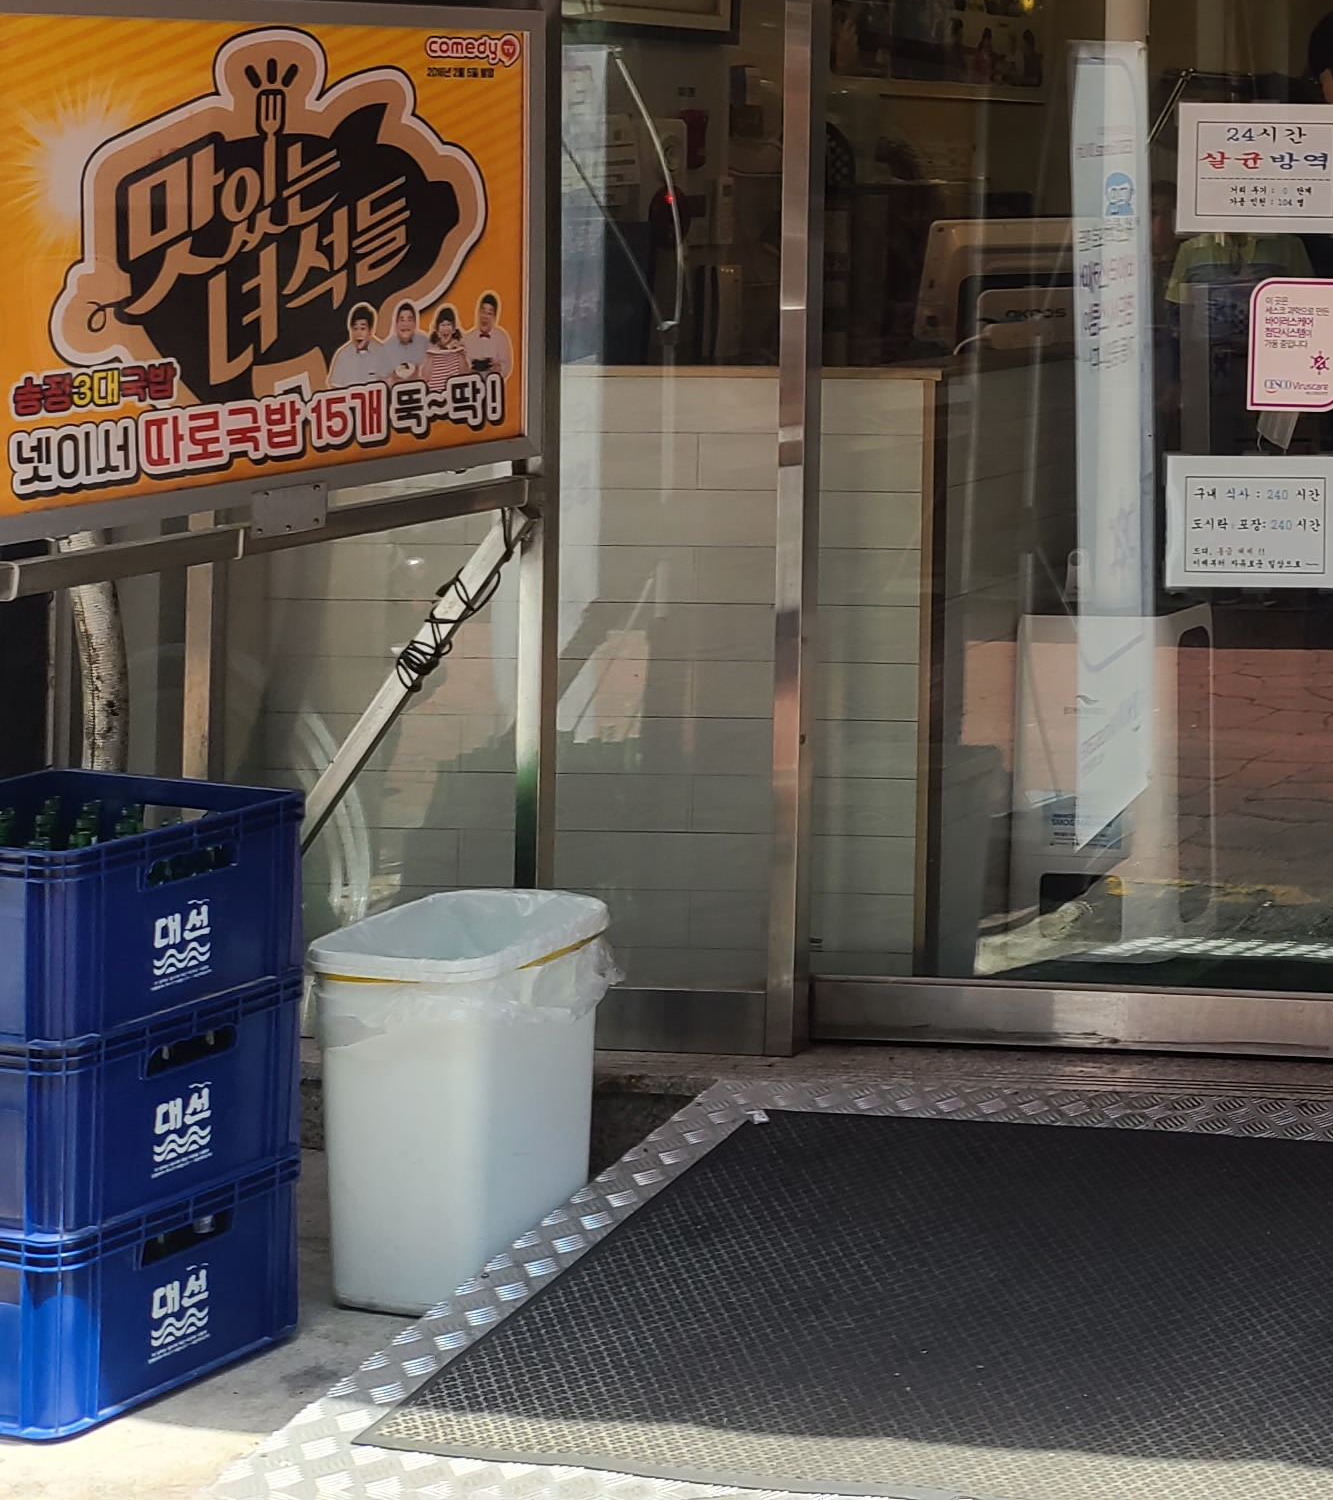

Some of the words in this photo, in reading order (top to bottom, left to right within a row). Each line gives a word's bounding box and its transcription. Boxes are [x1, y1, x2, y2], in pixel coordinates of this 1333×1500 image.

[427, 37, 499, 63] comedy
[1199, 150, 1264, 170] 살균
[1269, 151, 1329, 171] 방역
[1226, 125, 1308, 145] 24시간
[114, 138, 341, 316] 맛있는
[206, 174, 414, 387] 녀석들
[13, 361, 178, 417] 송정3대국밥
[15, 424, 132, 487] 넷이서
[143, 399, 302, 468] 따로국밥
[310, 388, 383, 441] 15개
[153, 901, 211, 949] 대선
[154, 1085, 212, 1135] 대선
[151, 1266, 209, 1319] 대선
